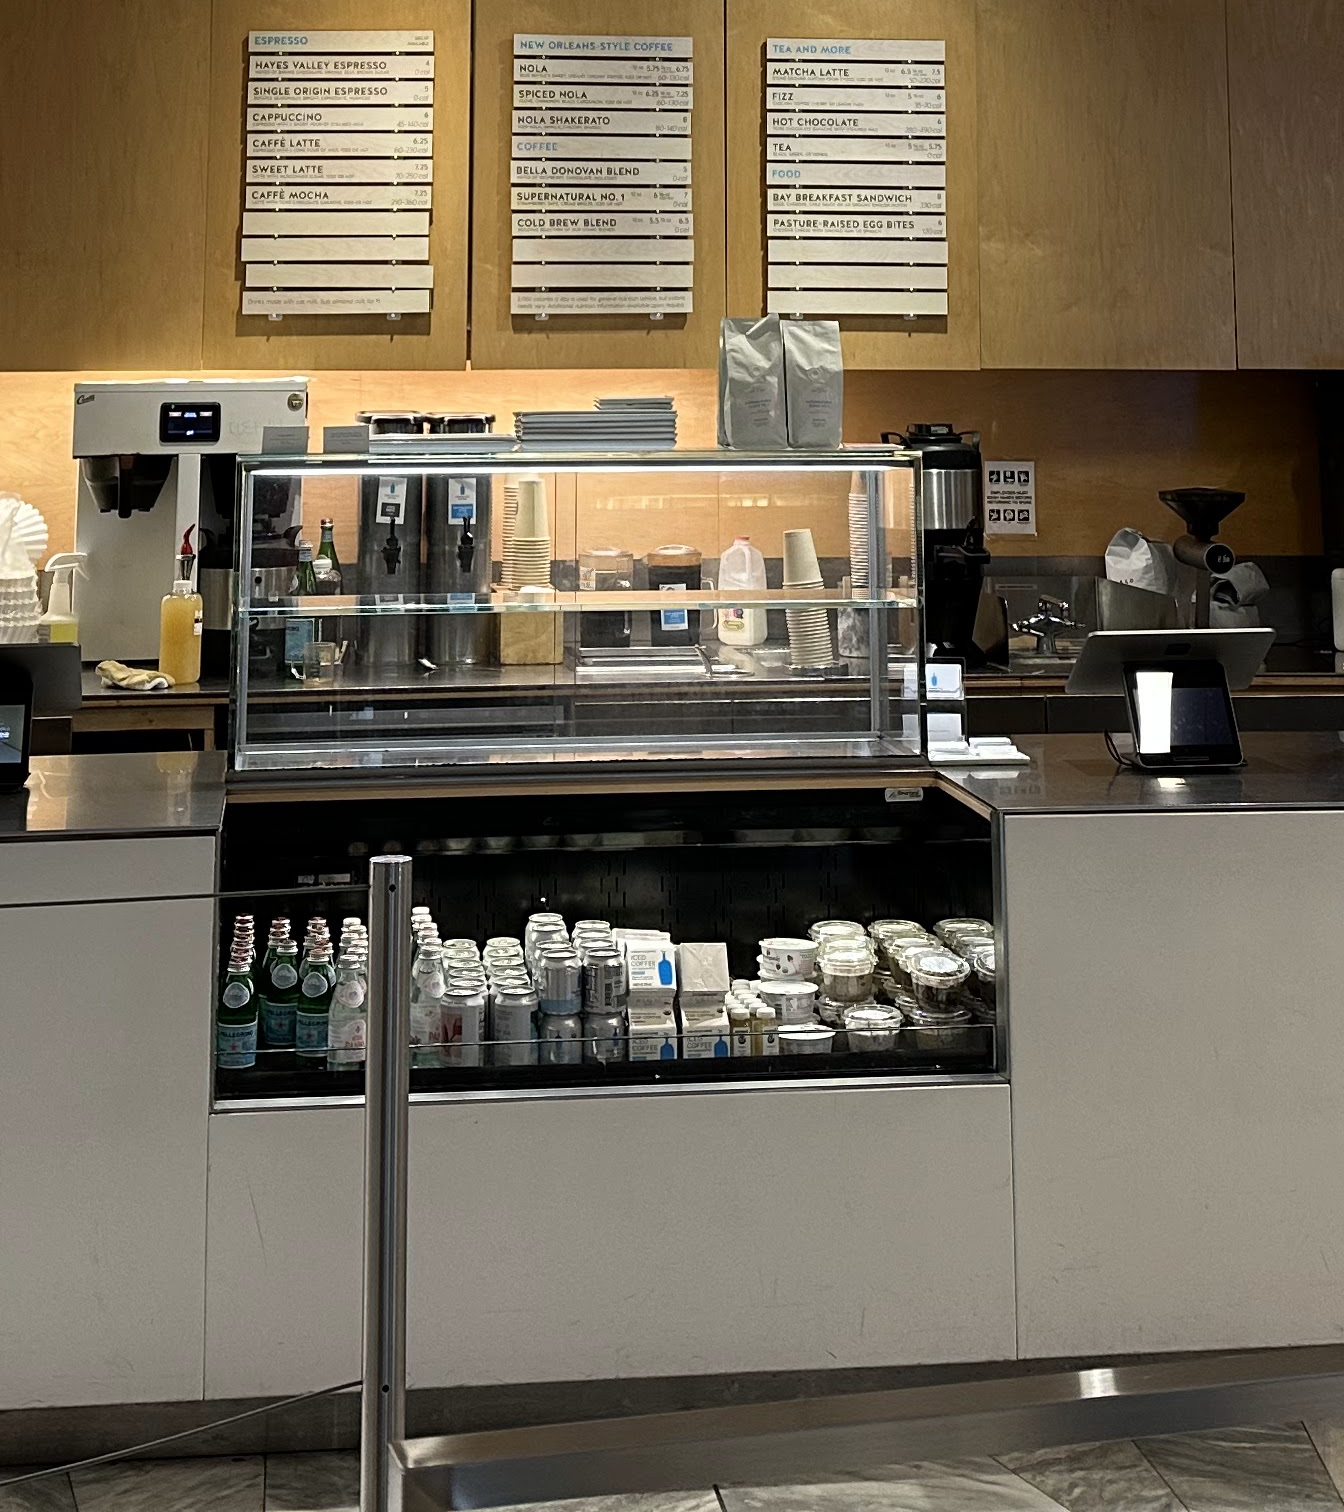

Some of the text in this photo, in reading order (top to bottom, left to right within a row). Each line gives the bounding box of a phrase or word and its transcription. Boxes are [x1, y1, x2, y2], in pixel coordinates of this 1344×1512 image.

[255, 36, 308, 45] ESPRESSO
[520, 41, 545, 50] NEW
[634, 43, 673, 52] COFFEE
[773, 45, 851, 54] TEA AND MORE
[255, 61, 289, 70] HAYES
[292, 61, 330, 70] VALLEY
[334, 61, 387, 70] ESPRESSO
[520, 64, 548, 73] NOLA
[773, 68, 816, 77] MATCHA
[819, 69, 849, 77] LATTE
[253, 87, 290, 96] SINGLE
[294, 87, 331, 96] ORIGIN
[334, 87, 388, 96] ESPRESSO
[519, 90, 556, 99] SPICED
[559, 91, 587, 99] NOLA
[772, 92, 794, 101] FIZZ
[253, 113, 322, 122] CAPPUCCINO
[518, 116, 546, 125] NOLA
[550, 116, 610, 125] SHAKERATO
[773, 118, 793, 126] HOT
[797, 118, 859, 127] CHOCOLATE
[253, 137, 286, 148] CAFFÈ
[290, 139, 320, 148] LATTE
[517, 142, 558, 151] COFFEE
[773, 143, 792, 152] TEA
[252, 165, 288, 174] SWEET
[293, 165, 323, 174] LATTE
[516, 166, 547, 175] BELLA
[552, 167, 603, 176] DONOVAN
[606, 167, 640, 176] BLEND
[772, 169, 801, 179] FOOD
[252, 189, 285, 200] CAFFÈ
[289, 191, 329, 200] MOCHA
[517, 192, 597, 201] SUPERNATURAL
[601, 192, 618, 201] NO.
[773, 193, 792, 202] BAY
[795, 194, 853, 203] BREAKFAST
[857, 194, 912, 203] SANDWICH
[518, 218, 546, 227] COLD
[549, 218, 579, 227] BREW
[583, 219, 617, 228] BLEND
[863, 220, 883, 229] EGG
[887, 220, 914, 229] BITES
